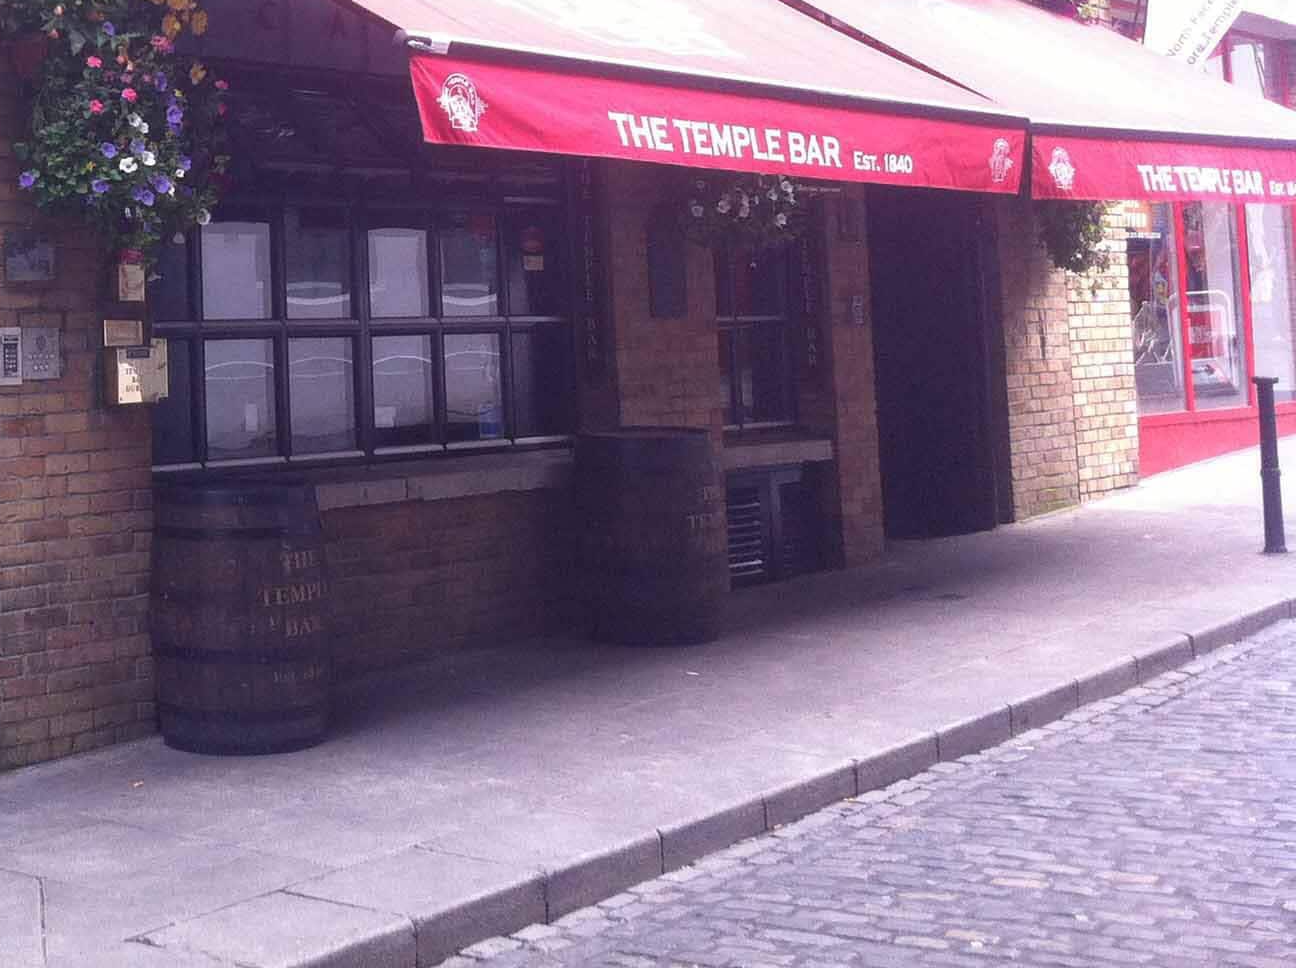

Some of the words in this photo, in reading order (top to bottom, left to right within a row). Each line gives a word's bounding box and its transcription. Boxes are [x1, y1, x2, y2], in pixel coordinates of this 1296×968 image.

[607, 111, 673, 152] THE
[671, 118, 785, 163] TEMPLE
[787, 130, 843, 168] BAR
[883, 153, 913, 174] 1840
[1136, 164, 1177, 192] THE
[1172, 165, 1232, 194] TEMPLE
[1231, 168, 1265, 196] BAR
